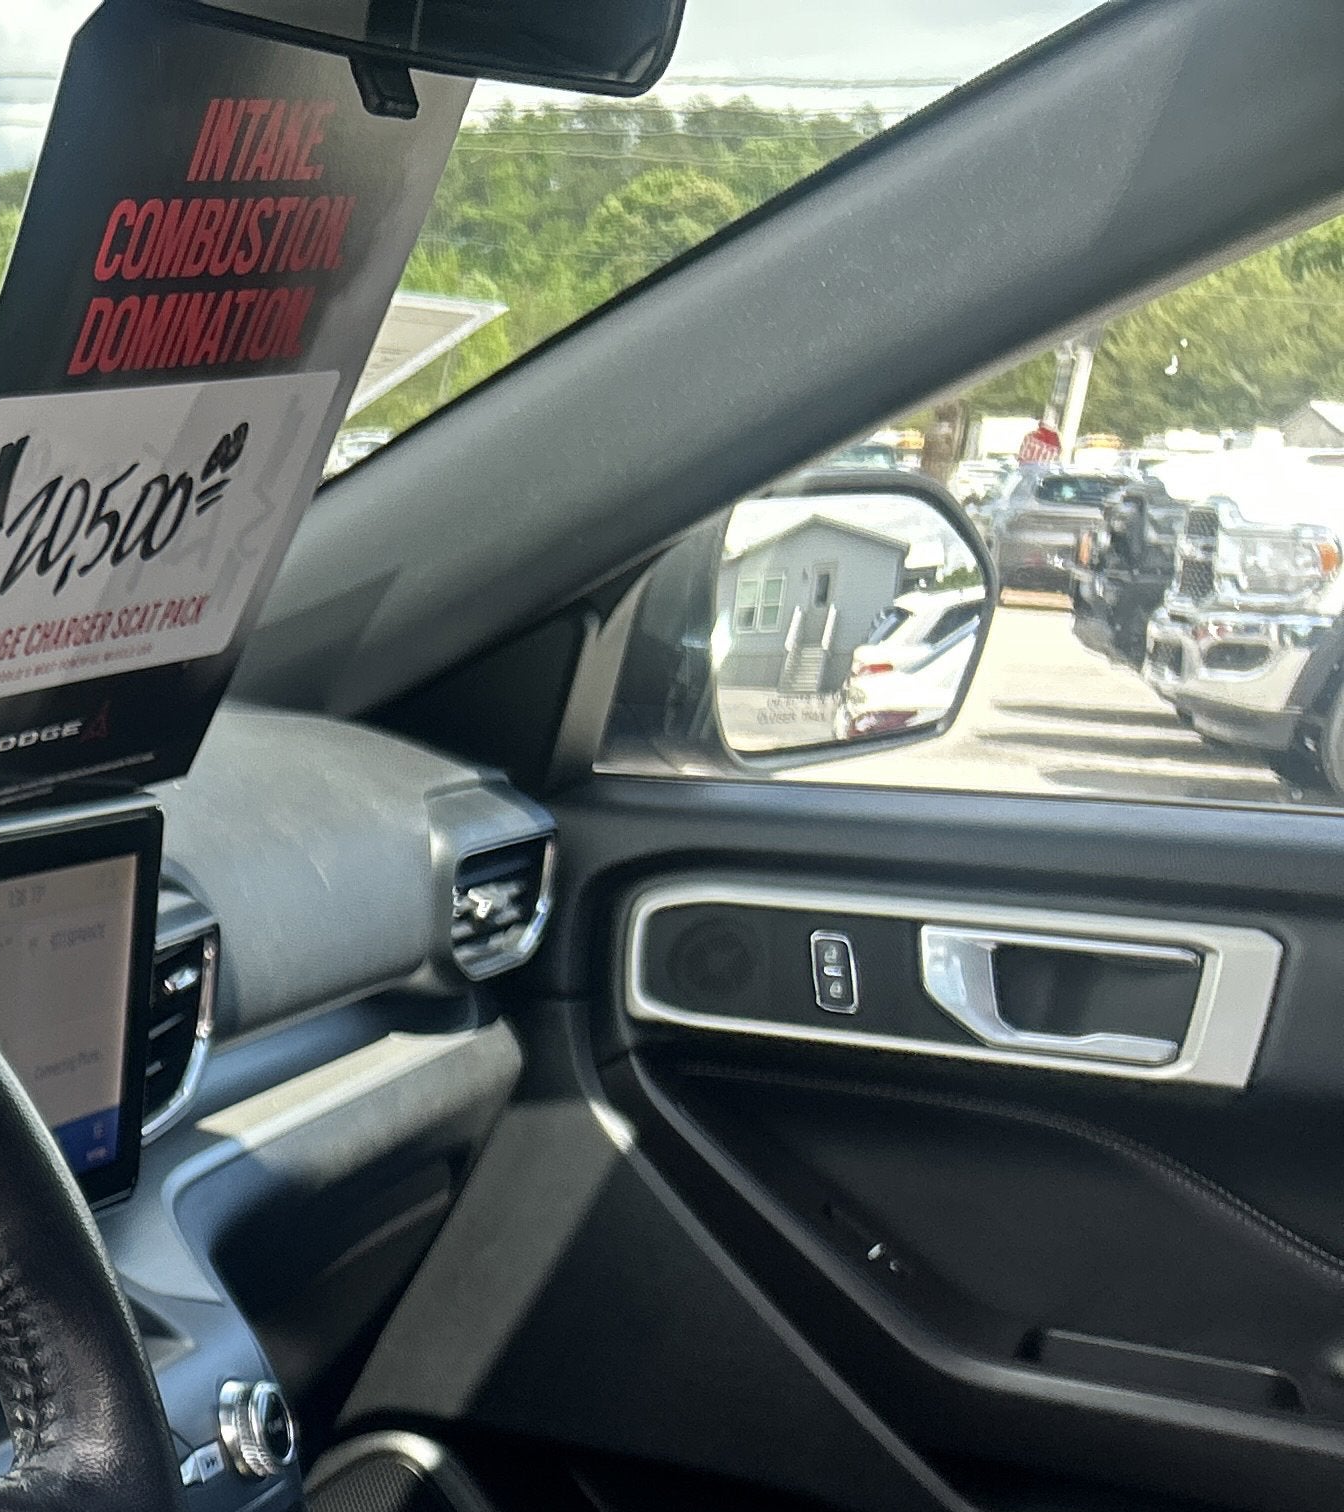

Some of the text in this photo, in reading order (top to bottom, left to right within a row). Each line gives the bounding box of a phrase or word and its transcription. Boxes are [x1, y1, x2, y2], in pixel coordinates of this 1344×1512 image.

[23, 611, 113, 656] CHARGER
[111, 601, 163, 640] SCAT
[158, 592, 210, 632] PACK
